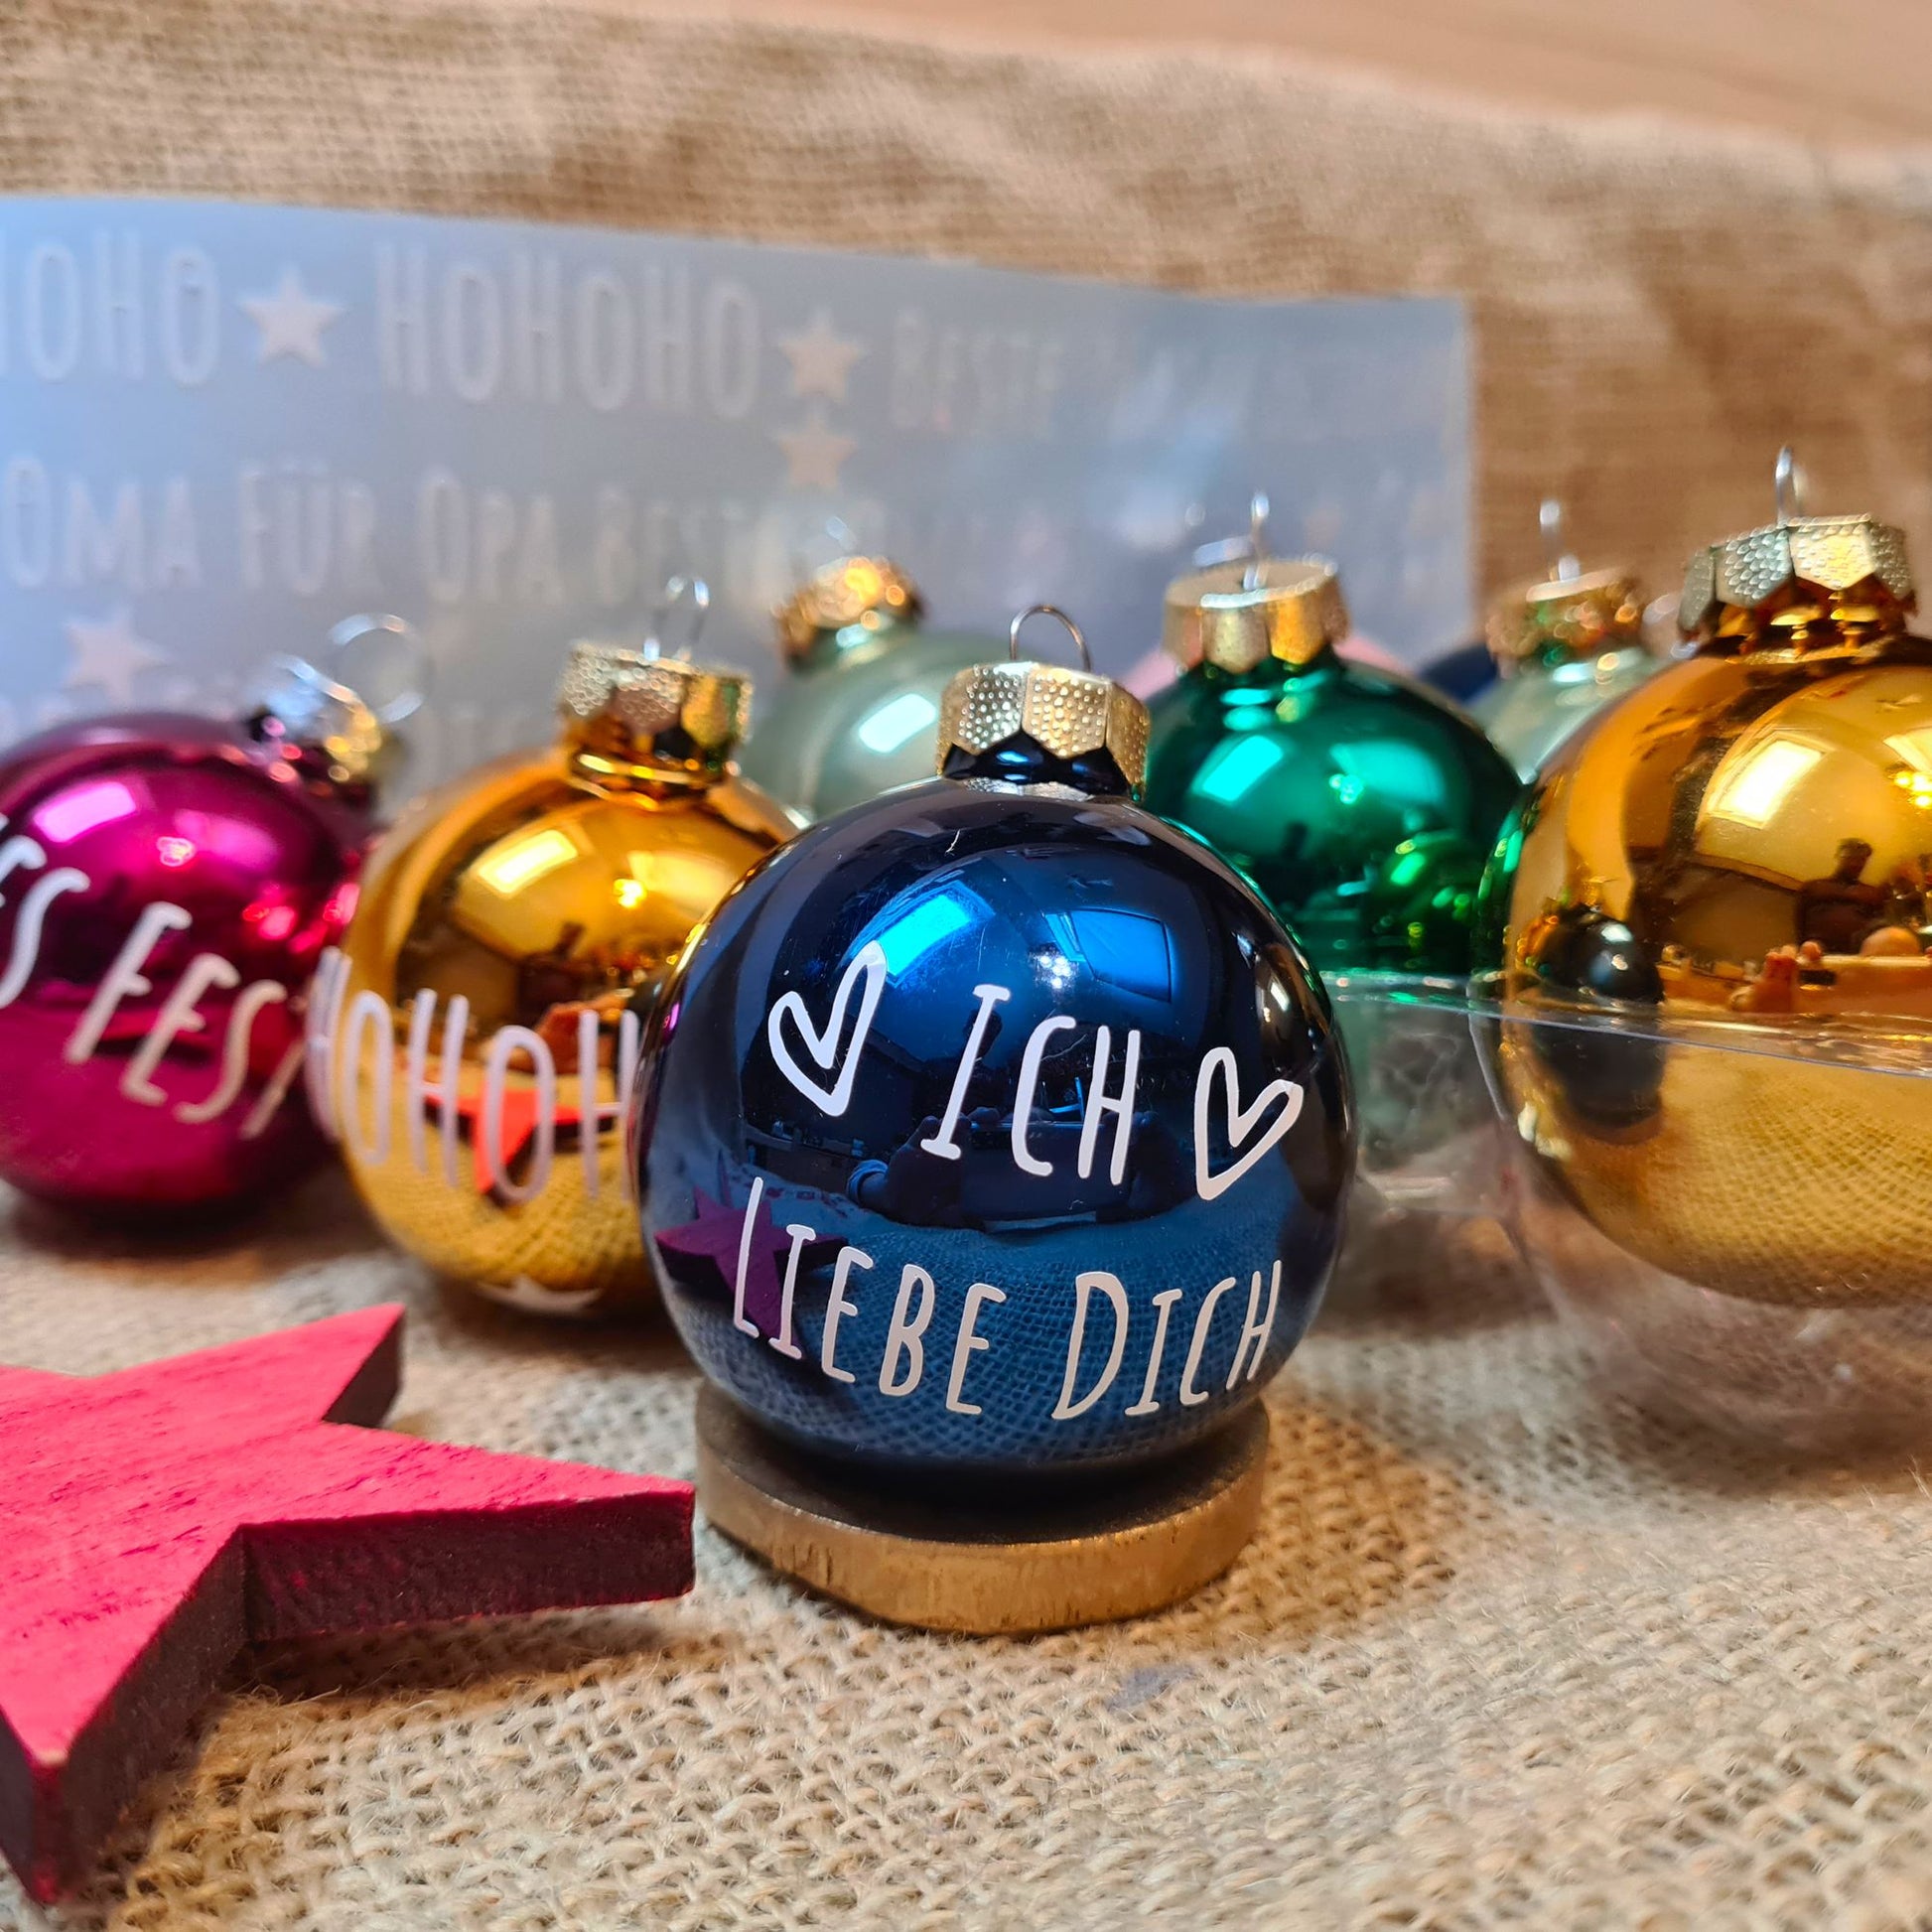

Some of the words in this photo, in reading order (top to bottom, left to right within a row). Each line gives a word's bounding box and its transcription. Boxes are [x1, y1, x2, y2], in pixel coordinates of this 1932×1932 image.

[0, 228, 220, 387] OHO
[375, 238, 760, 421] HOHOHO
[6, 455, 203, 590] OMA
[417, 465, 566, 604] OPA
[920, 984, 1141, 1185] ICH
[733, 1176, 1007, 1415] LIEBE
[1050, 1260, 1283, 1421] DICH
